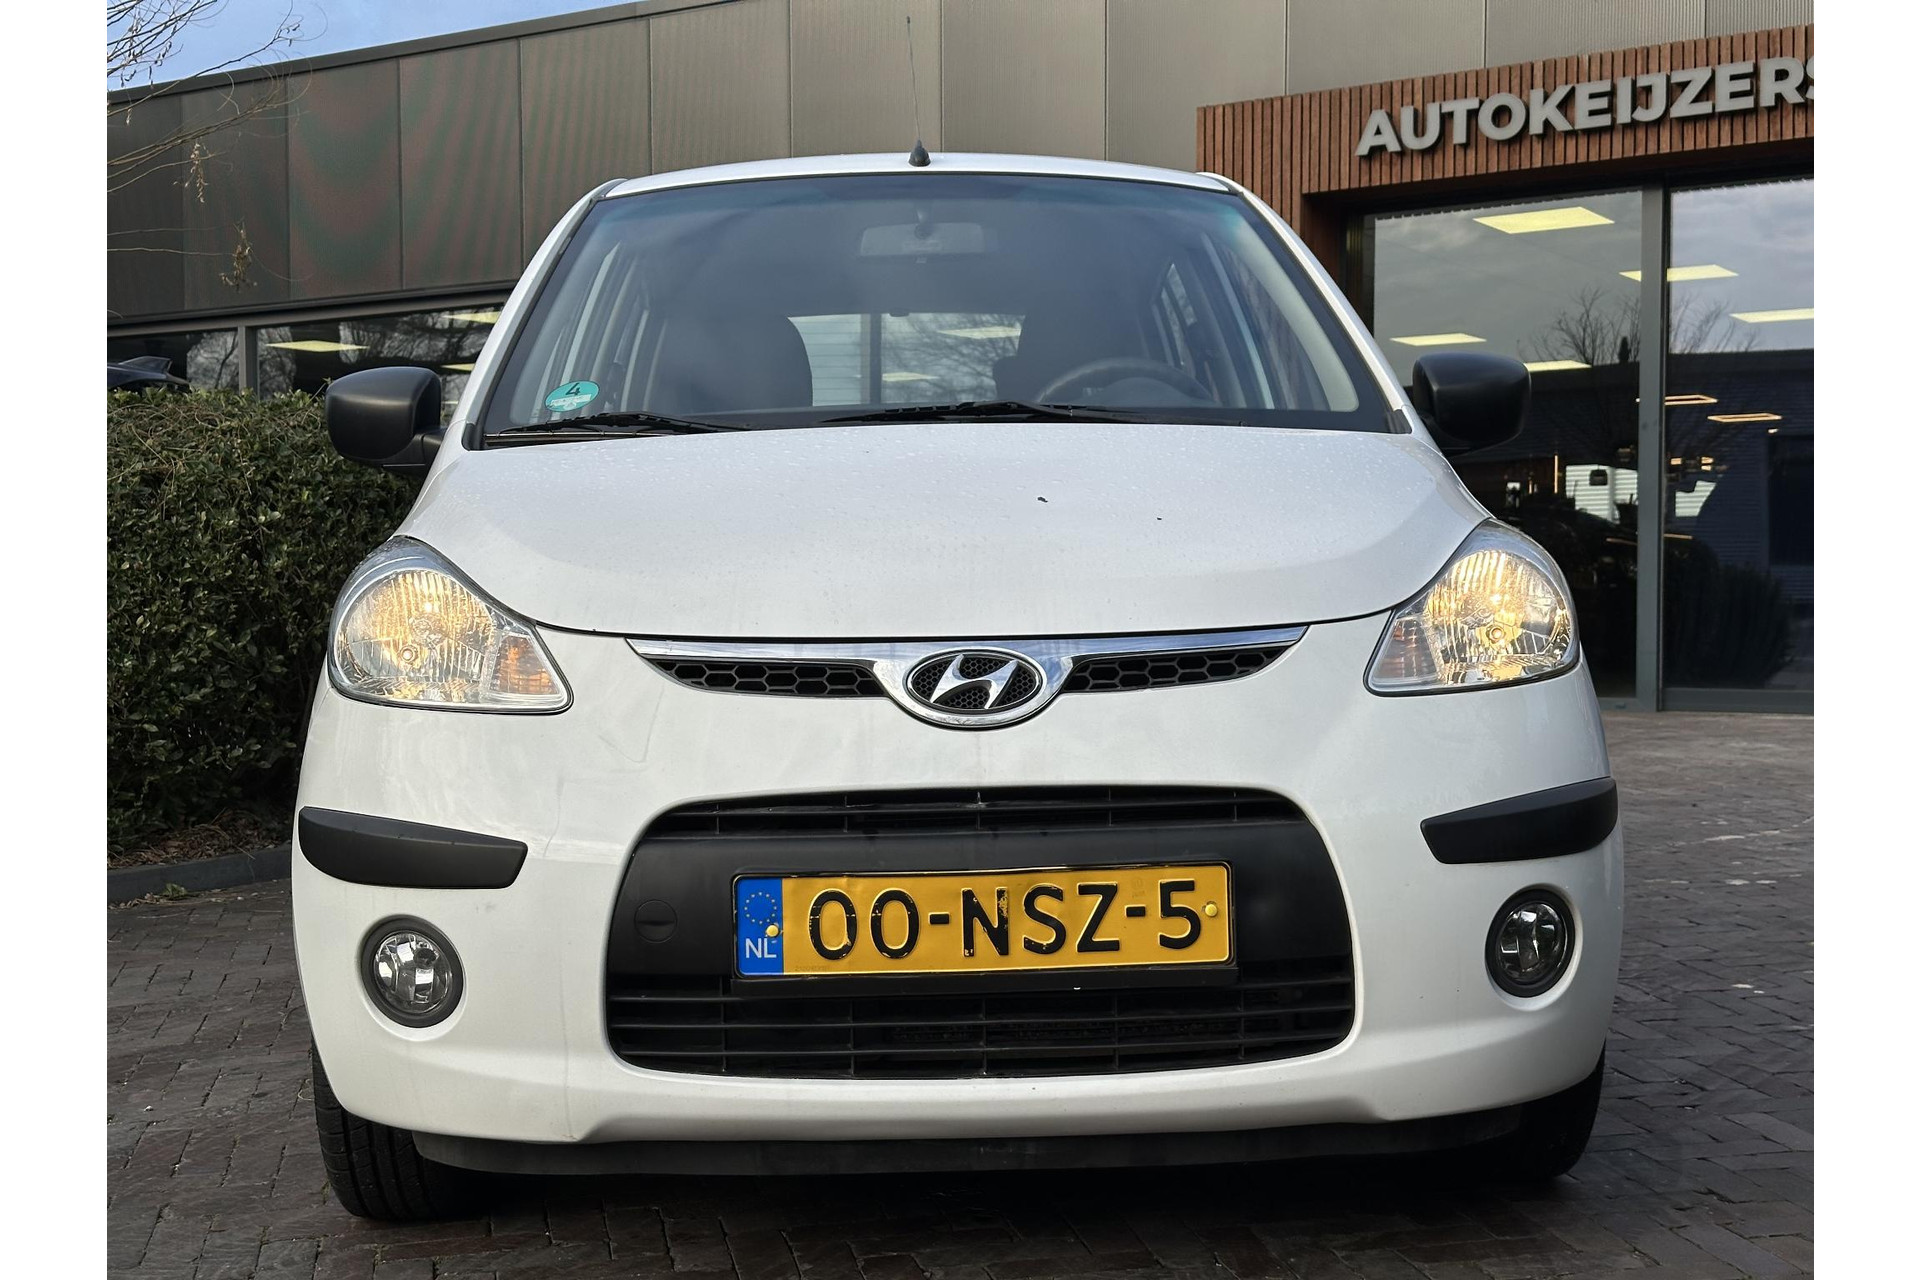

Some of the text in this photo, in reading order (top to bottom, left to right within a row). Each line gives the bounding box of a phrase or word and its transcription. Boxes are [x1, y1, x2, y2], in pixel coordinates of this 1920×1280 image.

[1355, 56, 1814, 157] AUTOKEIJZER
[565, 382, 581, 396] 4
[808, 879, 1202, 960] 00-NSZ-5
[745, 937, 777, 959] NL
